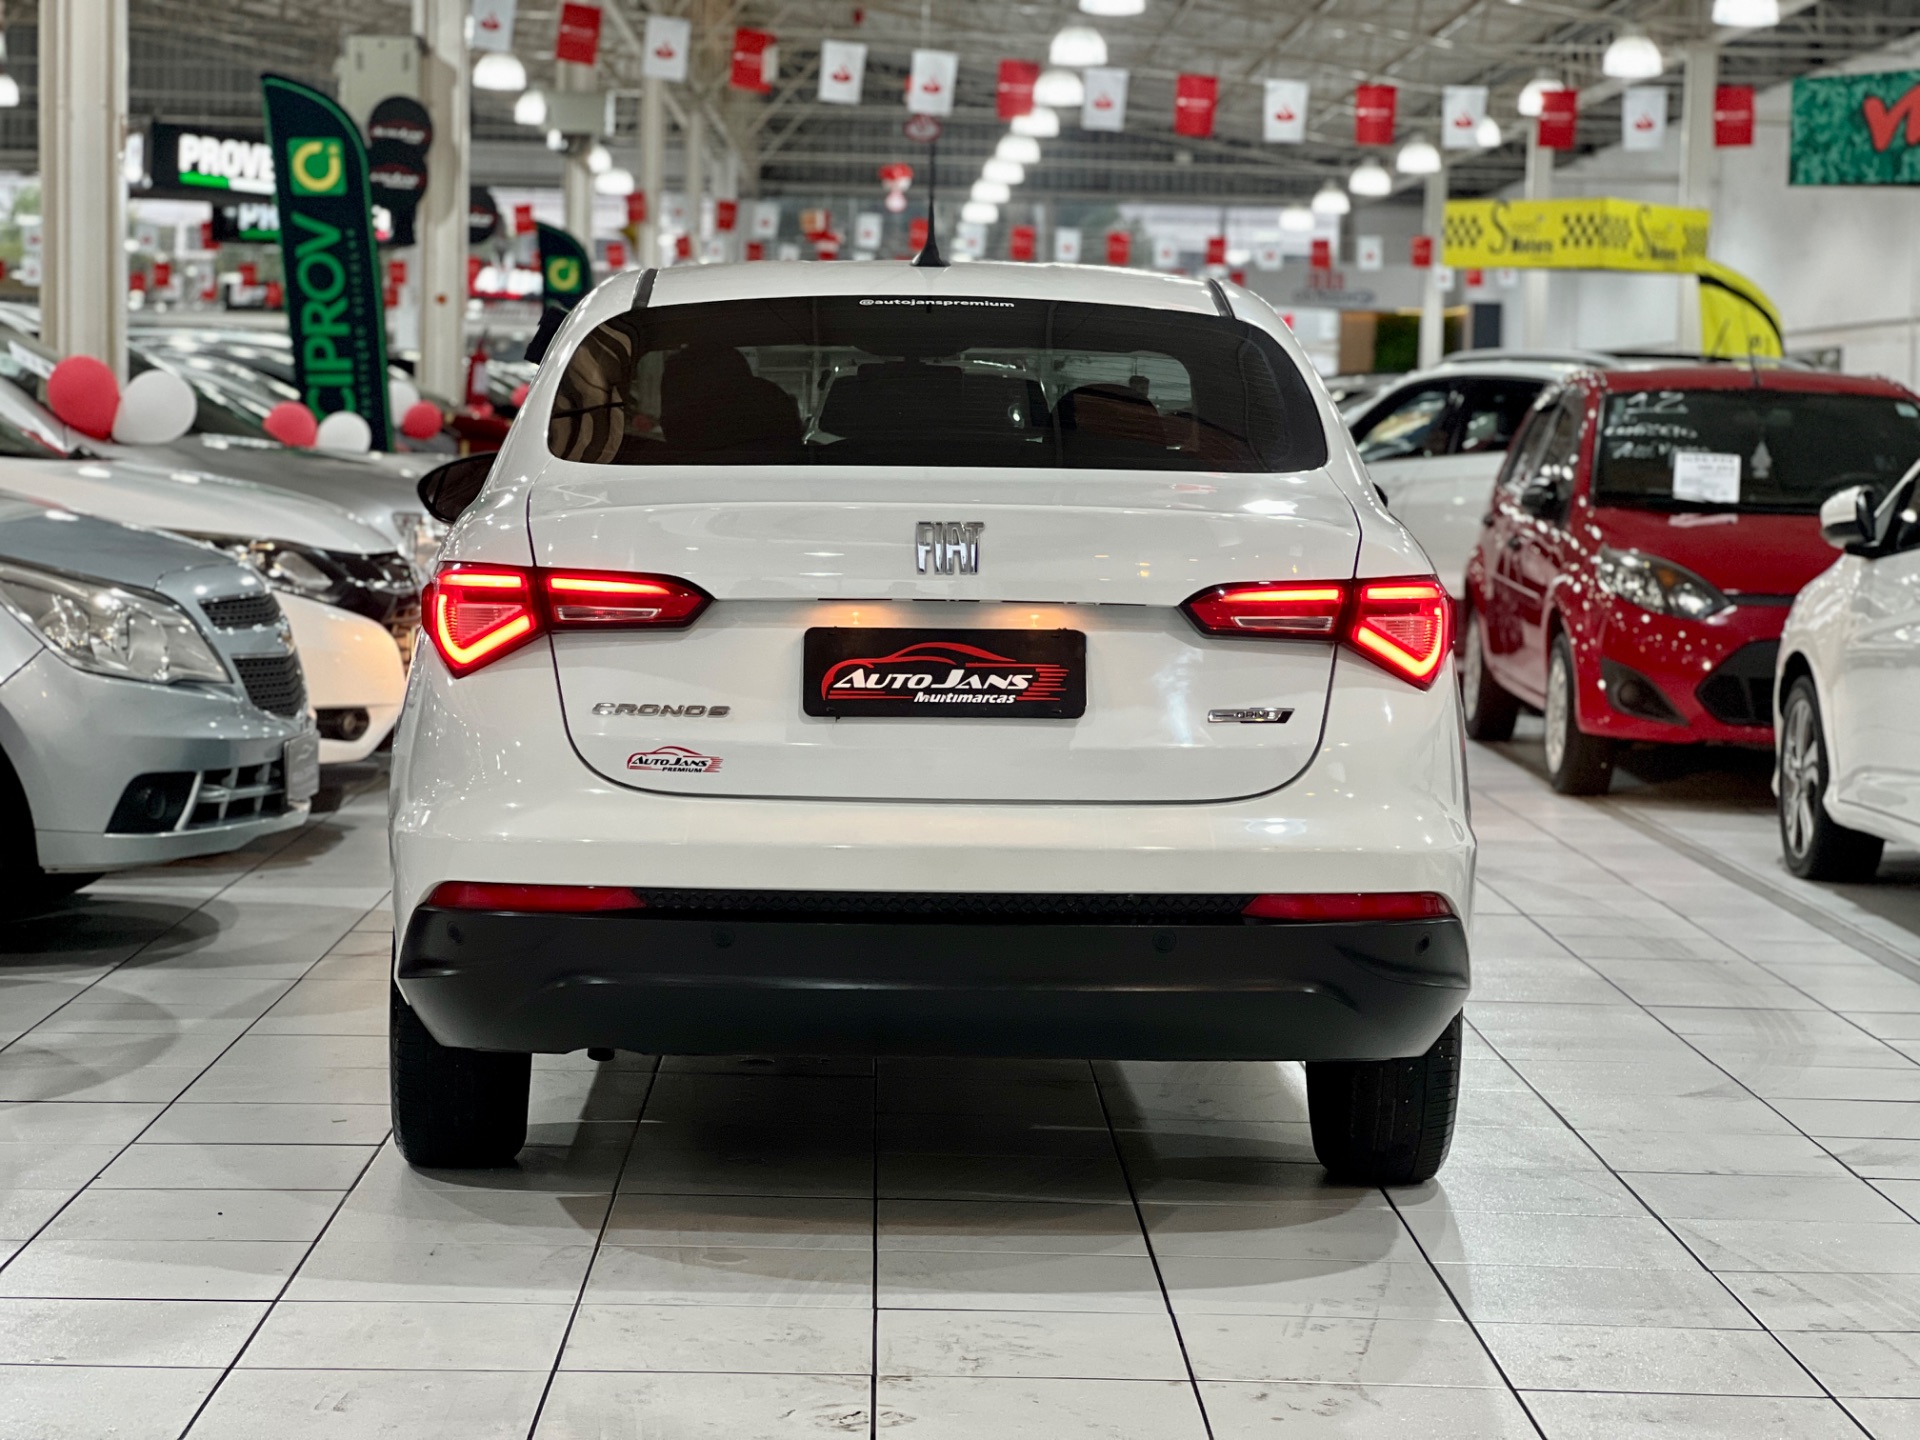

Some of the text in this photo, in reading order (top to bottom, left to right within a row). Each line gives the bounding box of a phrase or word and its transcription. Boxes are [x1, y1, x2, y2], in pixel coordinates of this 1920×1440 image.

[859, 299, 1015, 307] @autojanspremium
[915, 521, 985, 575] FIAT
[913, 691, 1016, 704] Multimarcas
[591, 702, 731, 719] CRONOS
